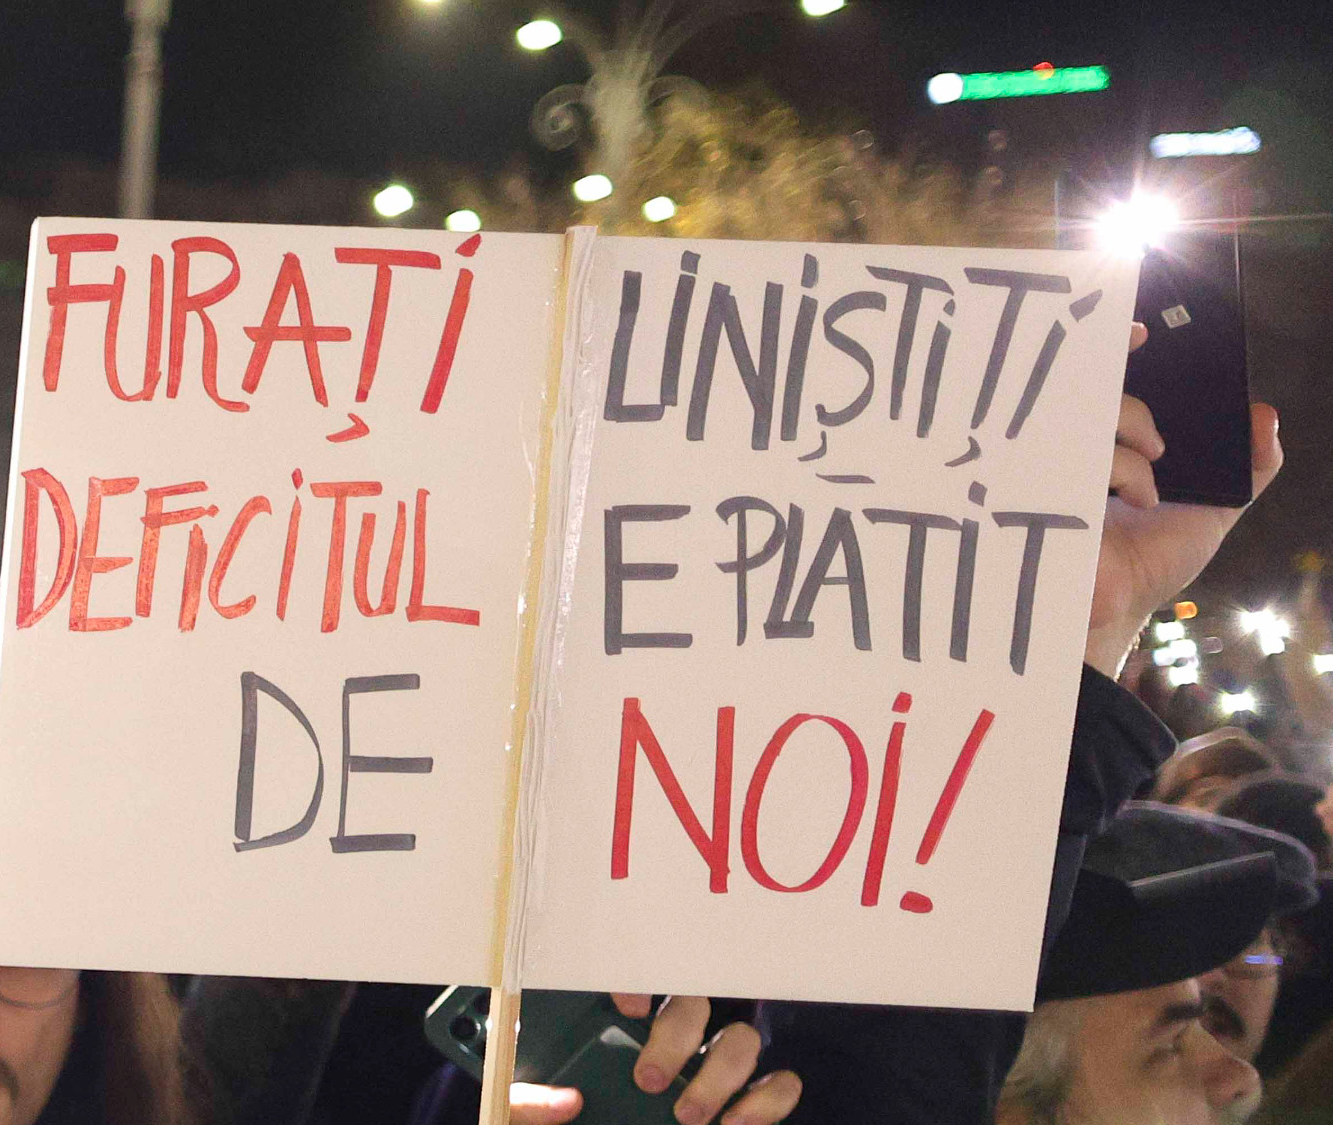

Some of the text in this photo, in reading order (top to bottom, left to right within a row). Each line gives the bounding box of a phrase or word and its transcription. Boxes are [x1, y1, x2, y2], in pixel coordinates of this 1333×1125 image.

[42, 232, 483, 444] FURAȚI
[14, 465, 482, 635] DEFICITUL
[604, 503, 693, 657] E
[232, 670, 997, 915] DE NOI!
